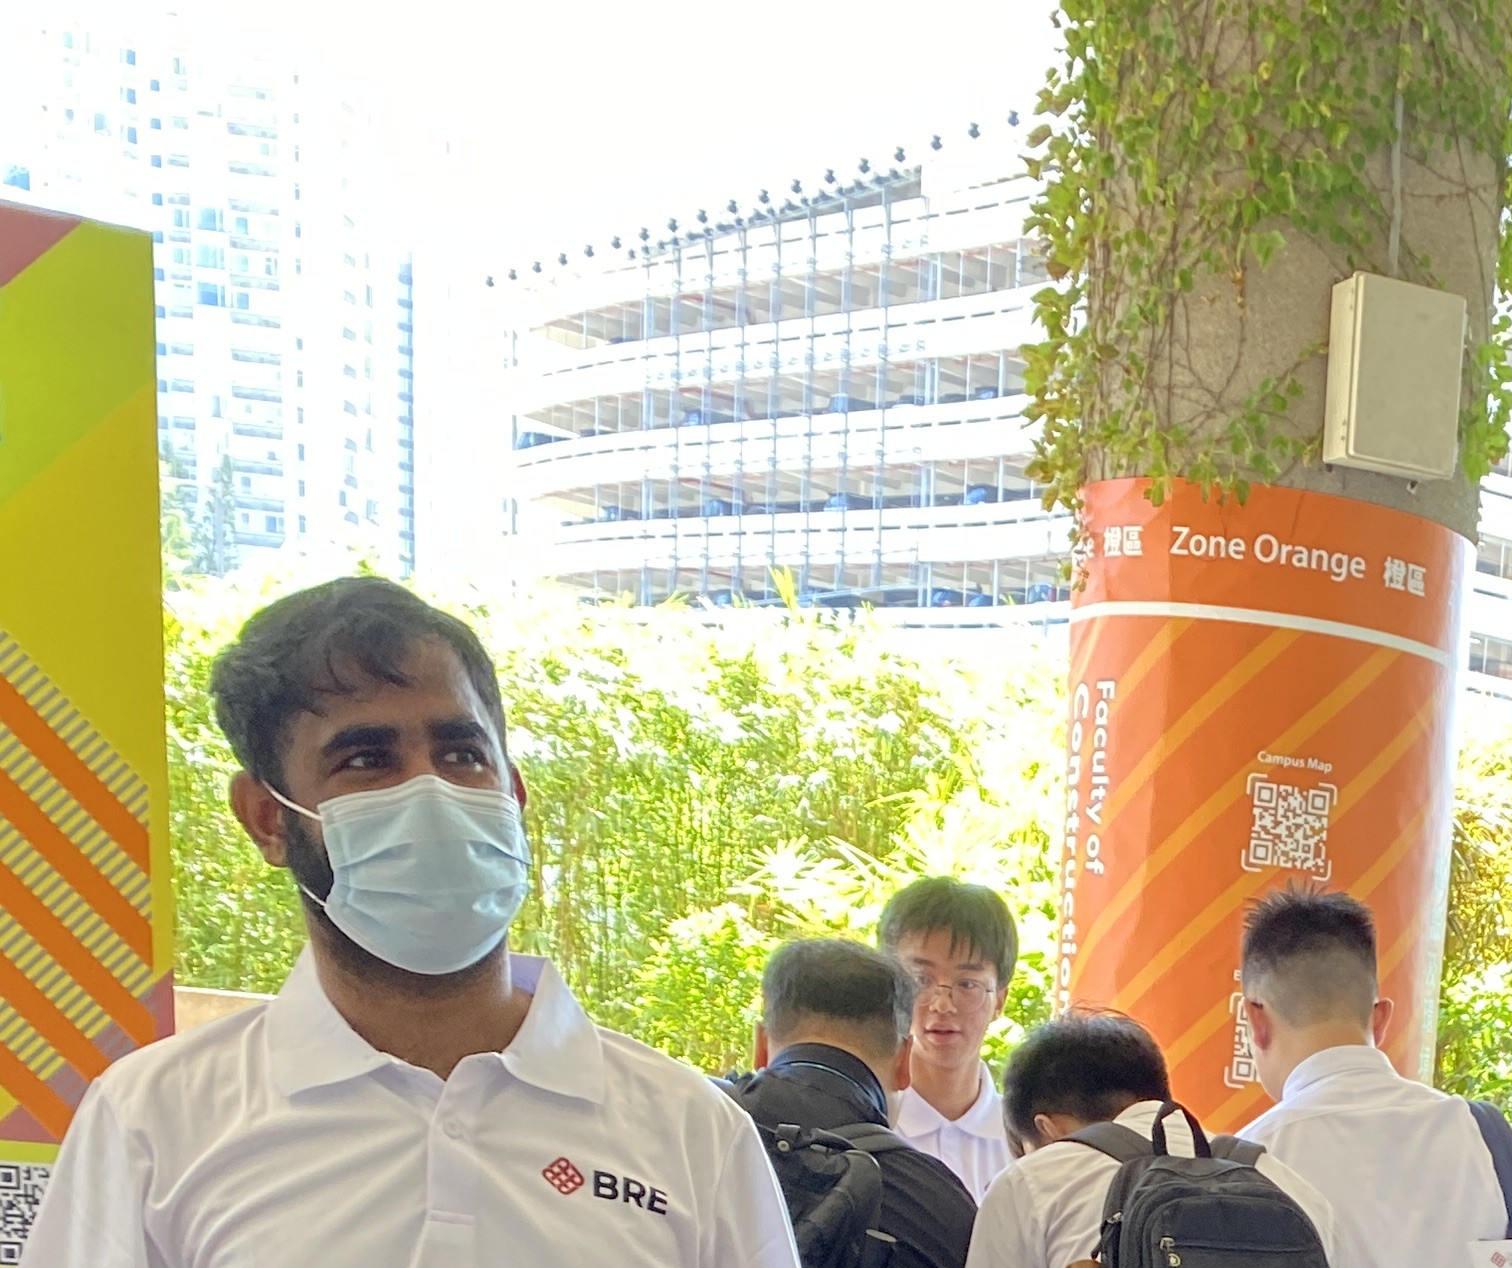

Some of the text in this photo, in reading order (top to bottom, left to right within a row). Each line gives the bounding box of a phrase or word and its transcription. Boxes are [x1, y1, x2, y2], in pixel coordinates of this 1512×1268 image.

[1103, 525, 1144, 557] 橙區
[1169, 525, 1366, 582] Zone Orange
[1382, 556, 1427, 597] 橙區
[1086, 680, 1116, 876] Faculty of
[1257, 750, 1333, 773] Campus Map
[593, 1170, 668, 1216] BRE
